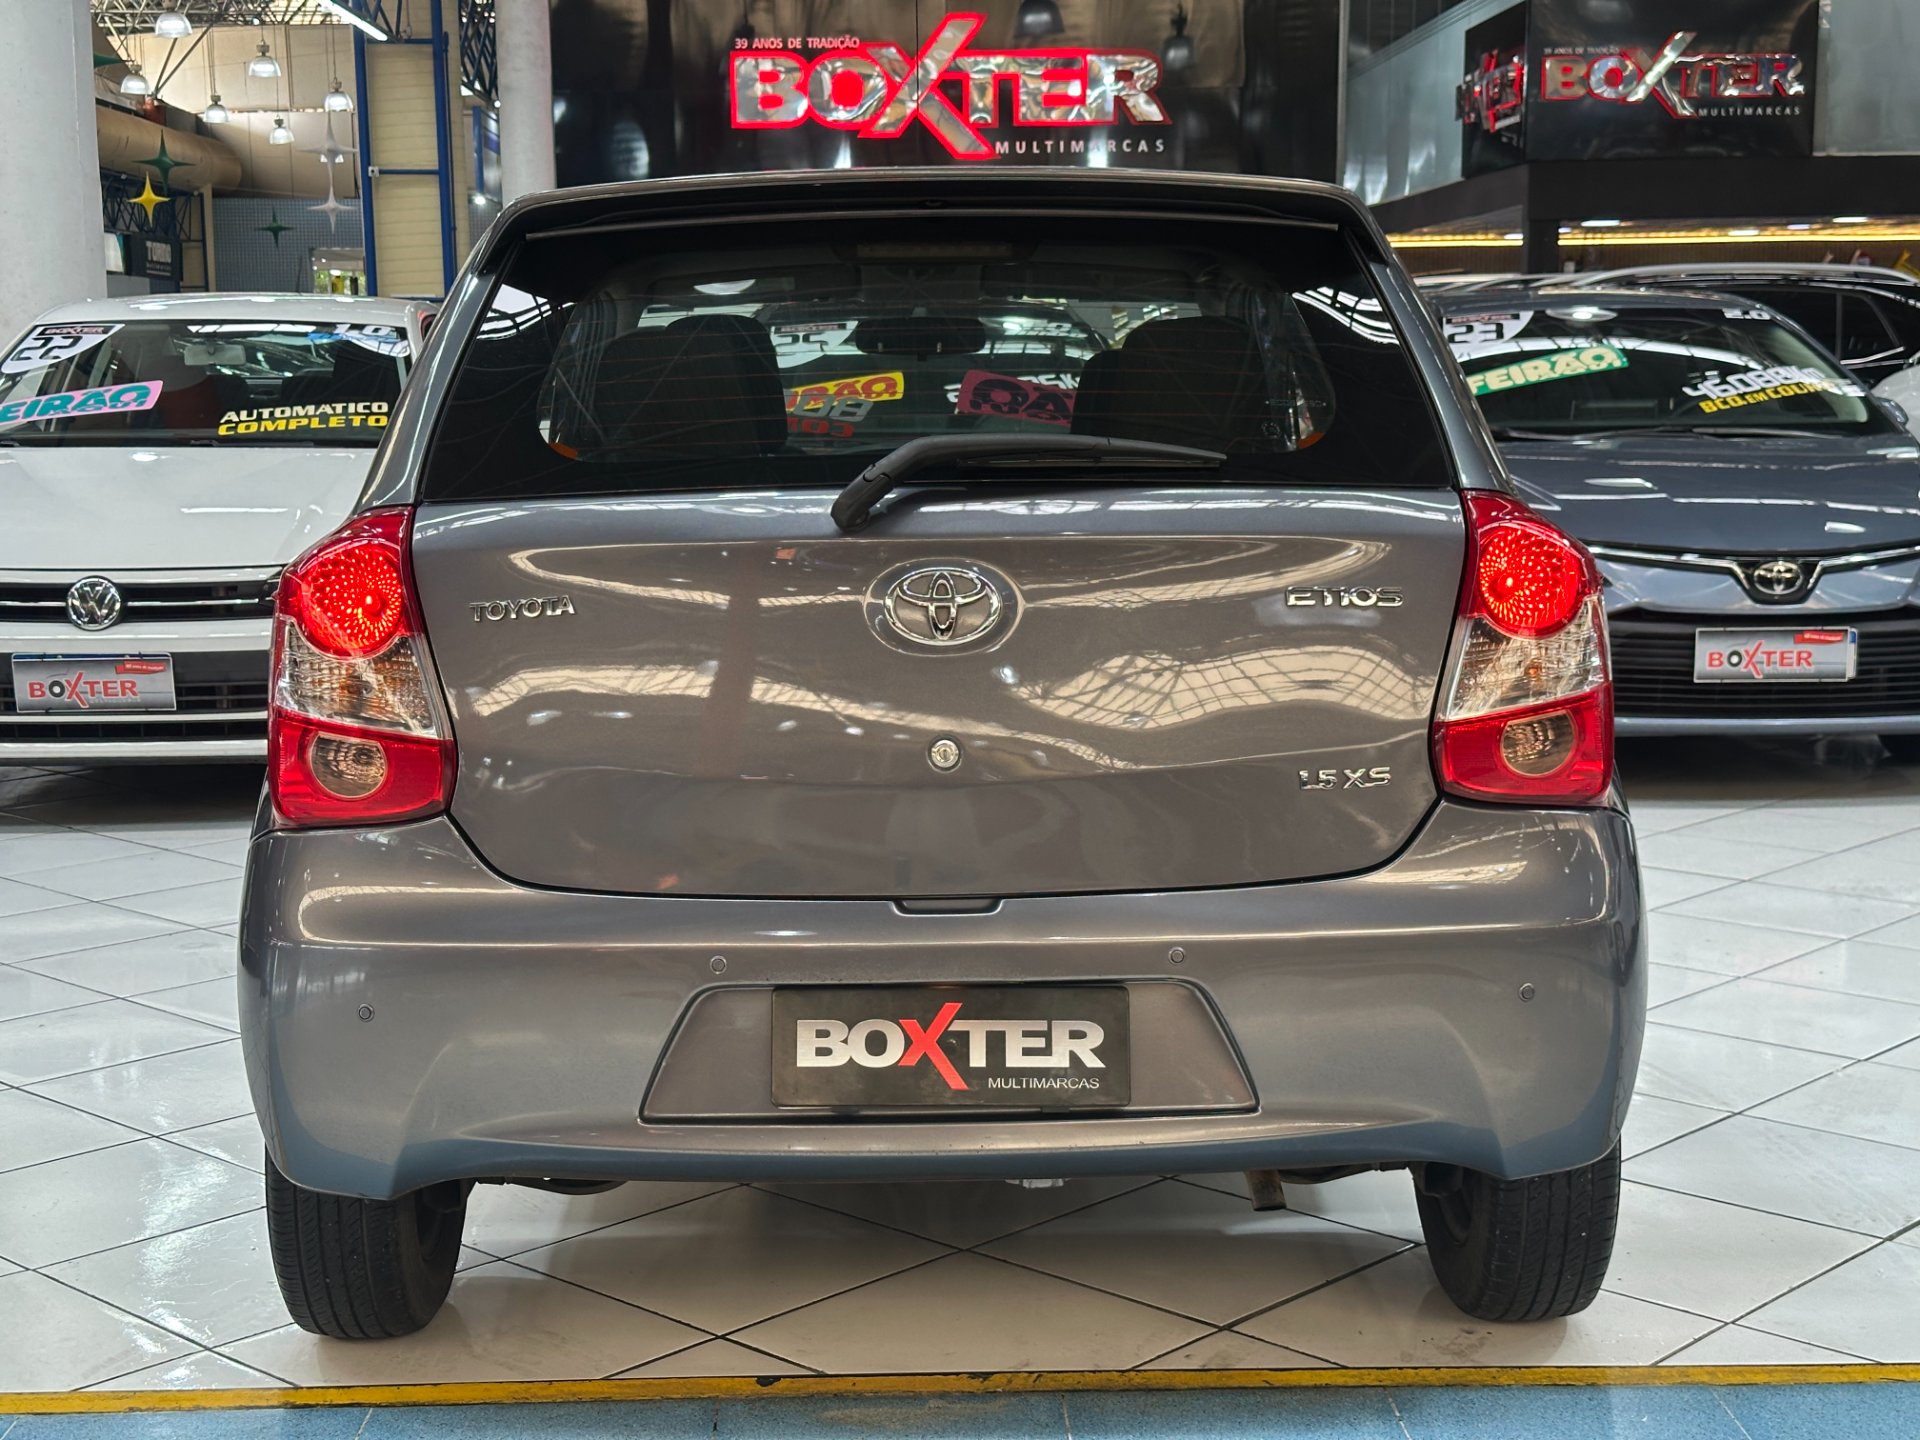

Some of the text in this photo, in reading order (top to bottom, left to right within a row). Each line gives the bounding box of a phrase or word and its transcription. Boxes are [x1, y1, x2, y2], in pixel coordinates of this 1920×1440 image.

[735, 34, 860, 50] 39 ANOS DE TRADIÇÃO
[730, 12, 1172, 160] BOXTER
[1541, 31, 1805, 119] BOXTER
[1698, 105, 1801, 118] MULTIMARCAS
[995, 139, 1165, 155] MULTIMARCAS
[1447, 322, 1505, 343] 23
[10, 335, 83, 361] 22
[217, 414, 388, 436] COMPLETO
[469, 594, 575, 622] TOYOTA
[1706, 640, 1814, 679] BOXTER
[27, 671, 140, 708] BOXTER
[1343, 766, 1391, 789] XS
[796, 1002, 1106, 1090] BOXTER
[987, 1077, 1100, 1090] MULTIMARCAS
